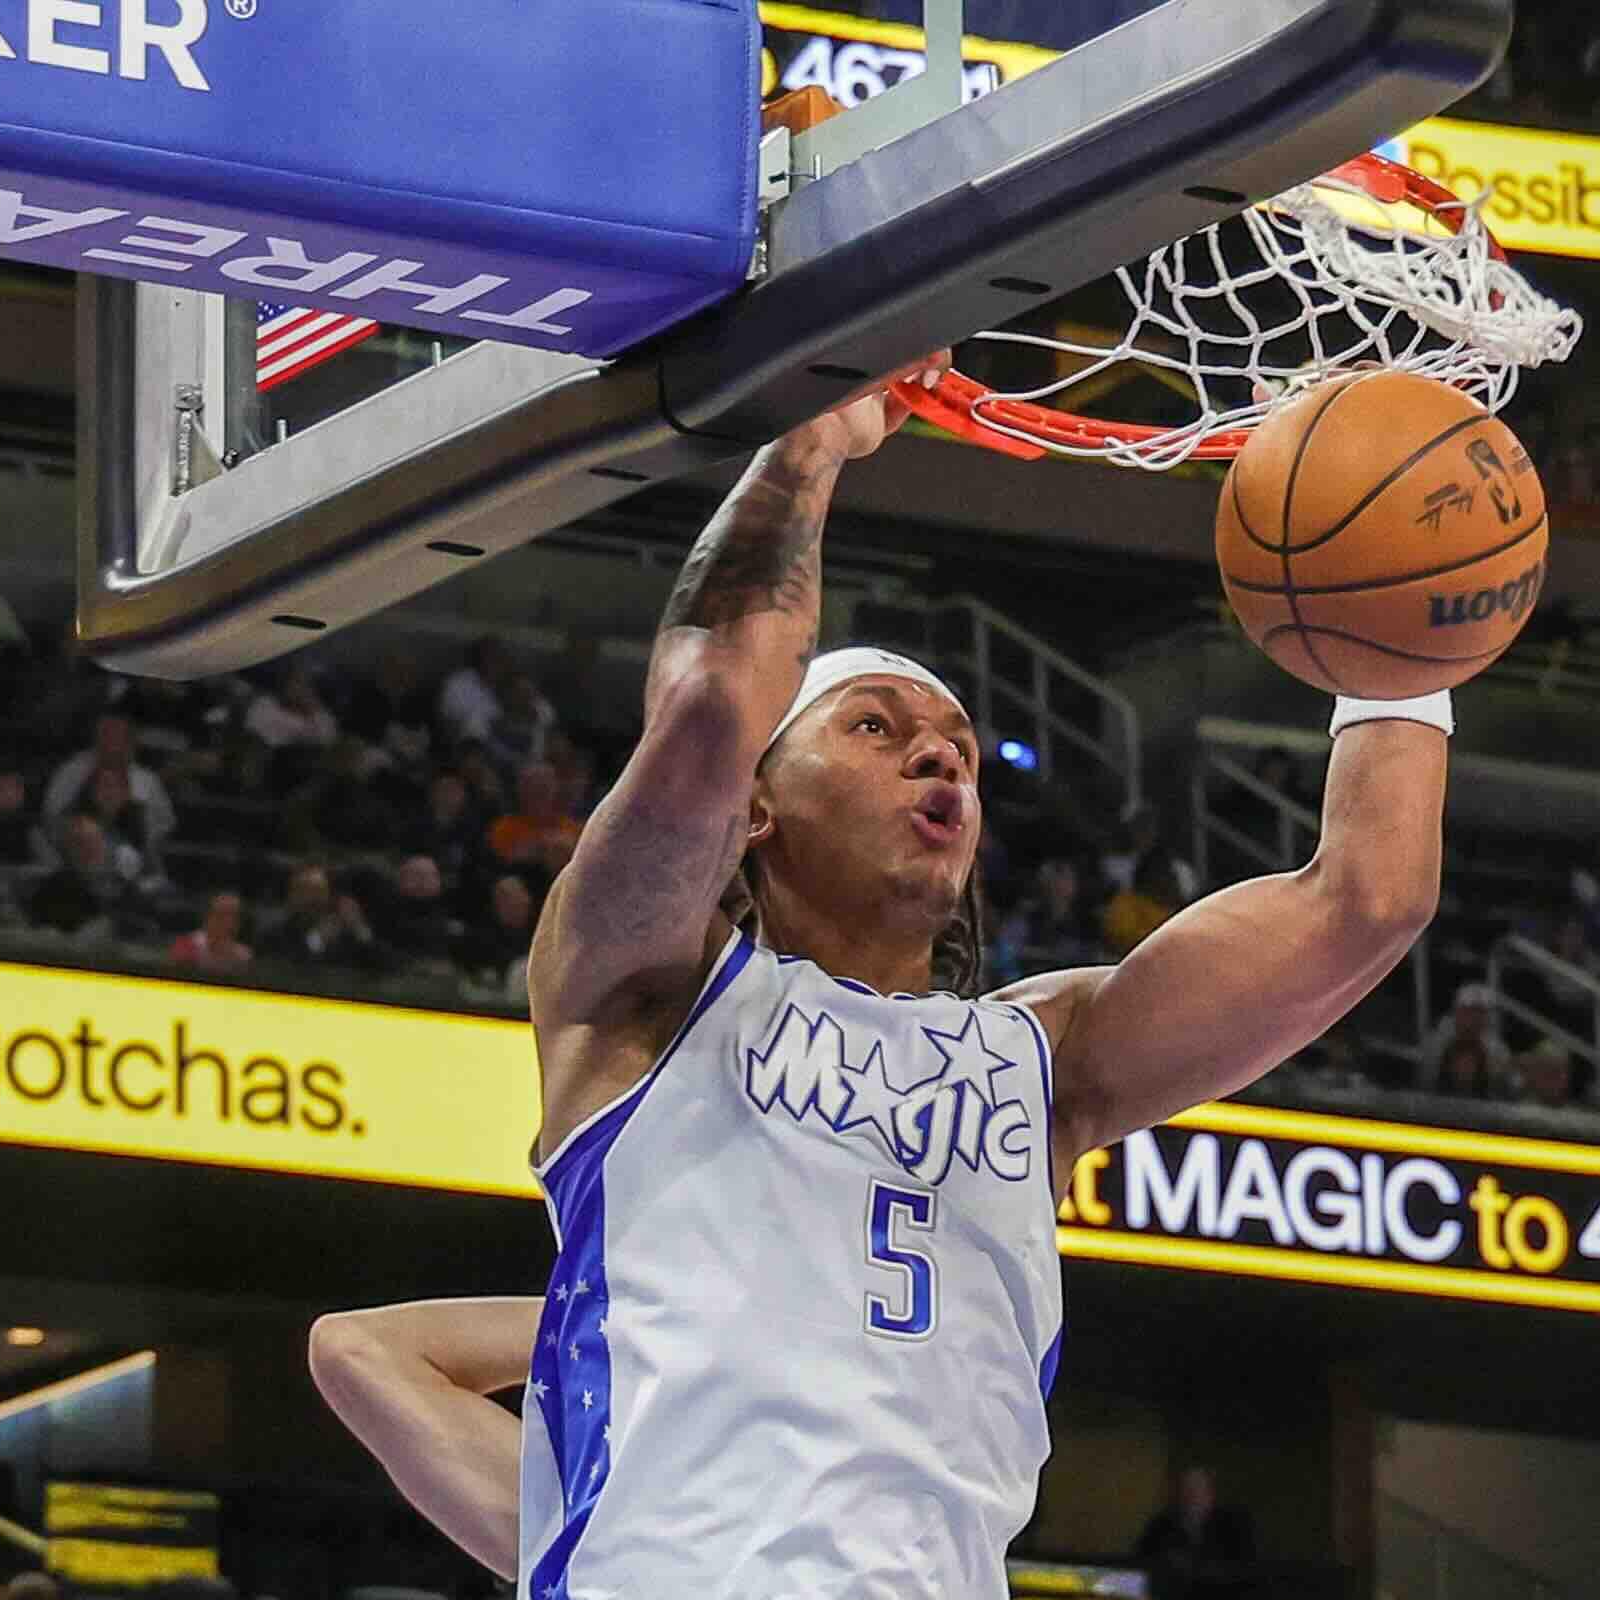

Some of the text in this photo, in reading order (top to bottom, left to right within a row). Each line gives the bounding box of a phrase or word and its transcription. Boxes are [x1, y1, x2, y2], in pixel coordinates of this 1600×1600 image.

[865, 1177, 938, 1342] 5
[1124, 1128, 1460, 1262] MAGIC
[1471, 1175, 1568, 1275] to
